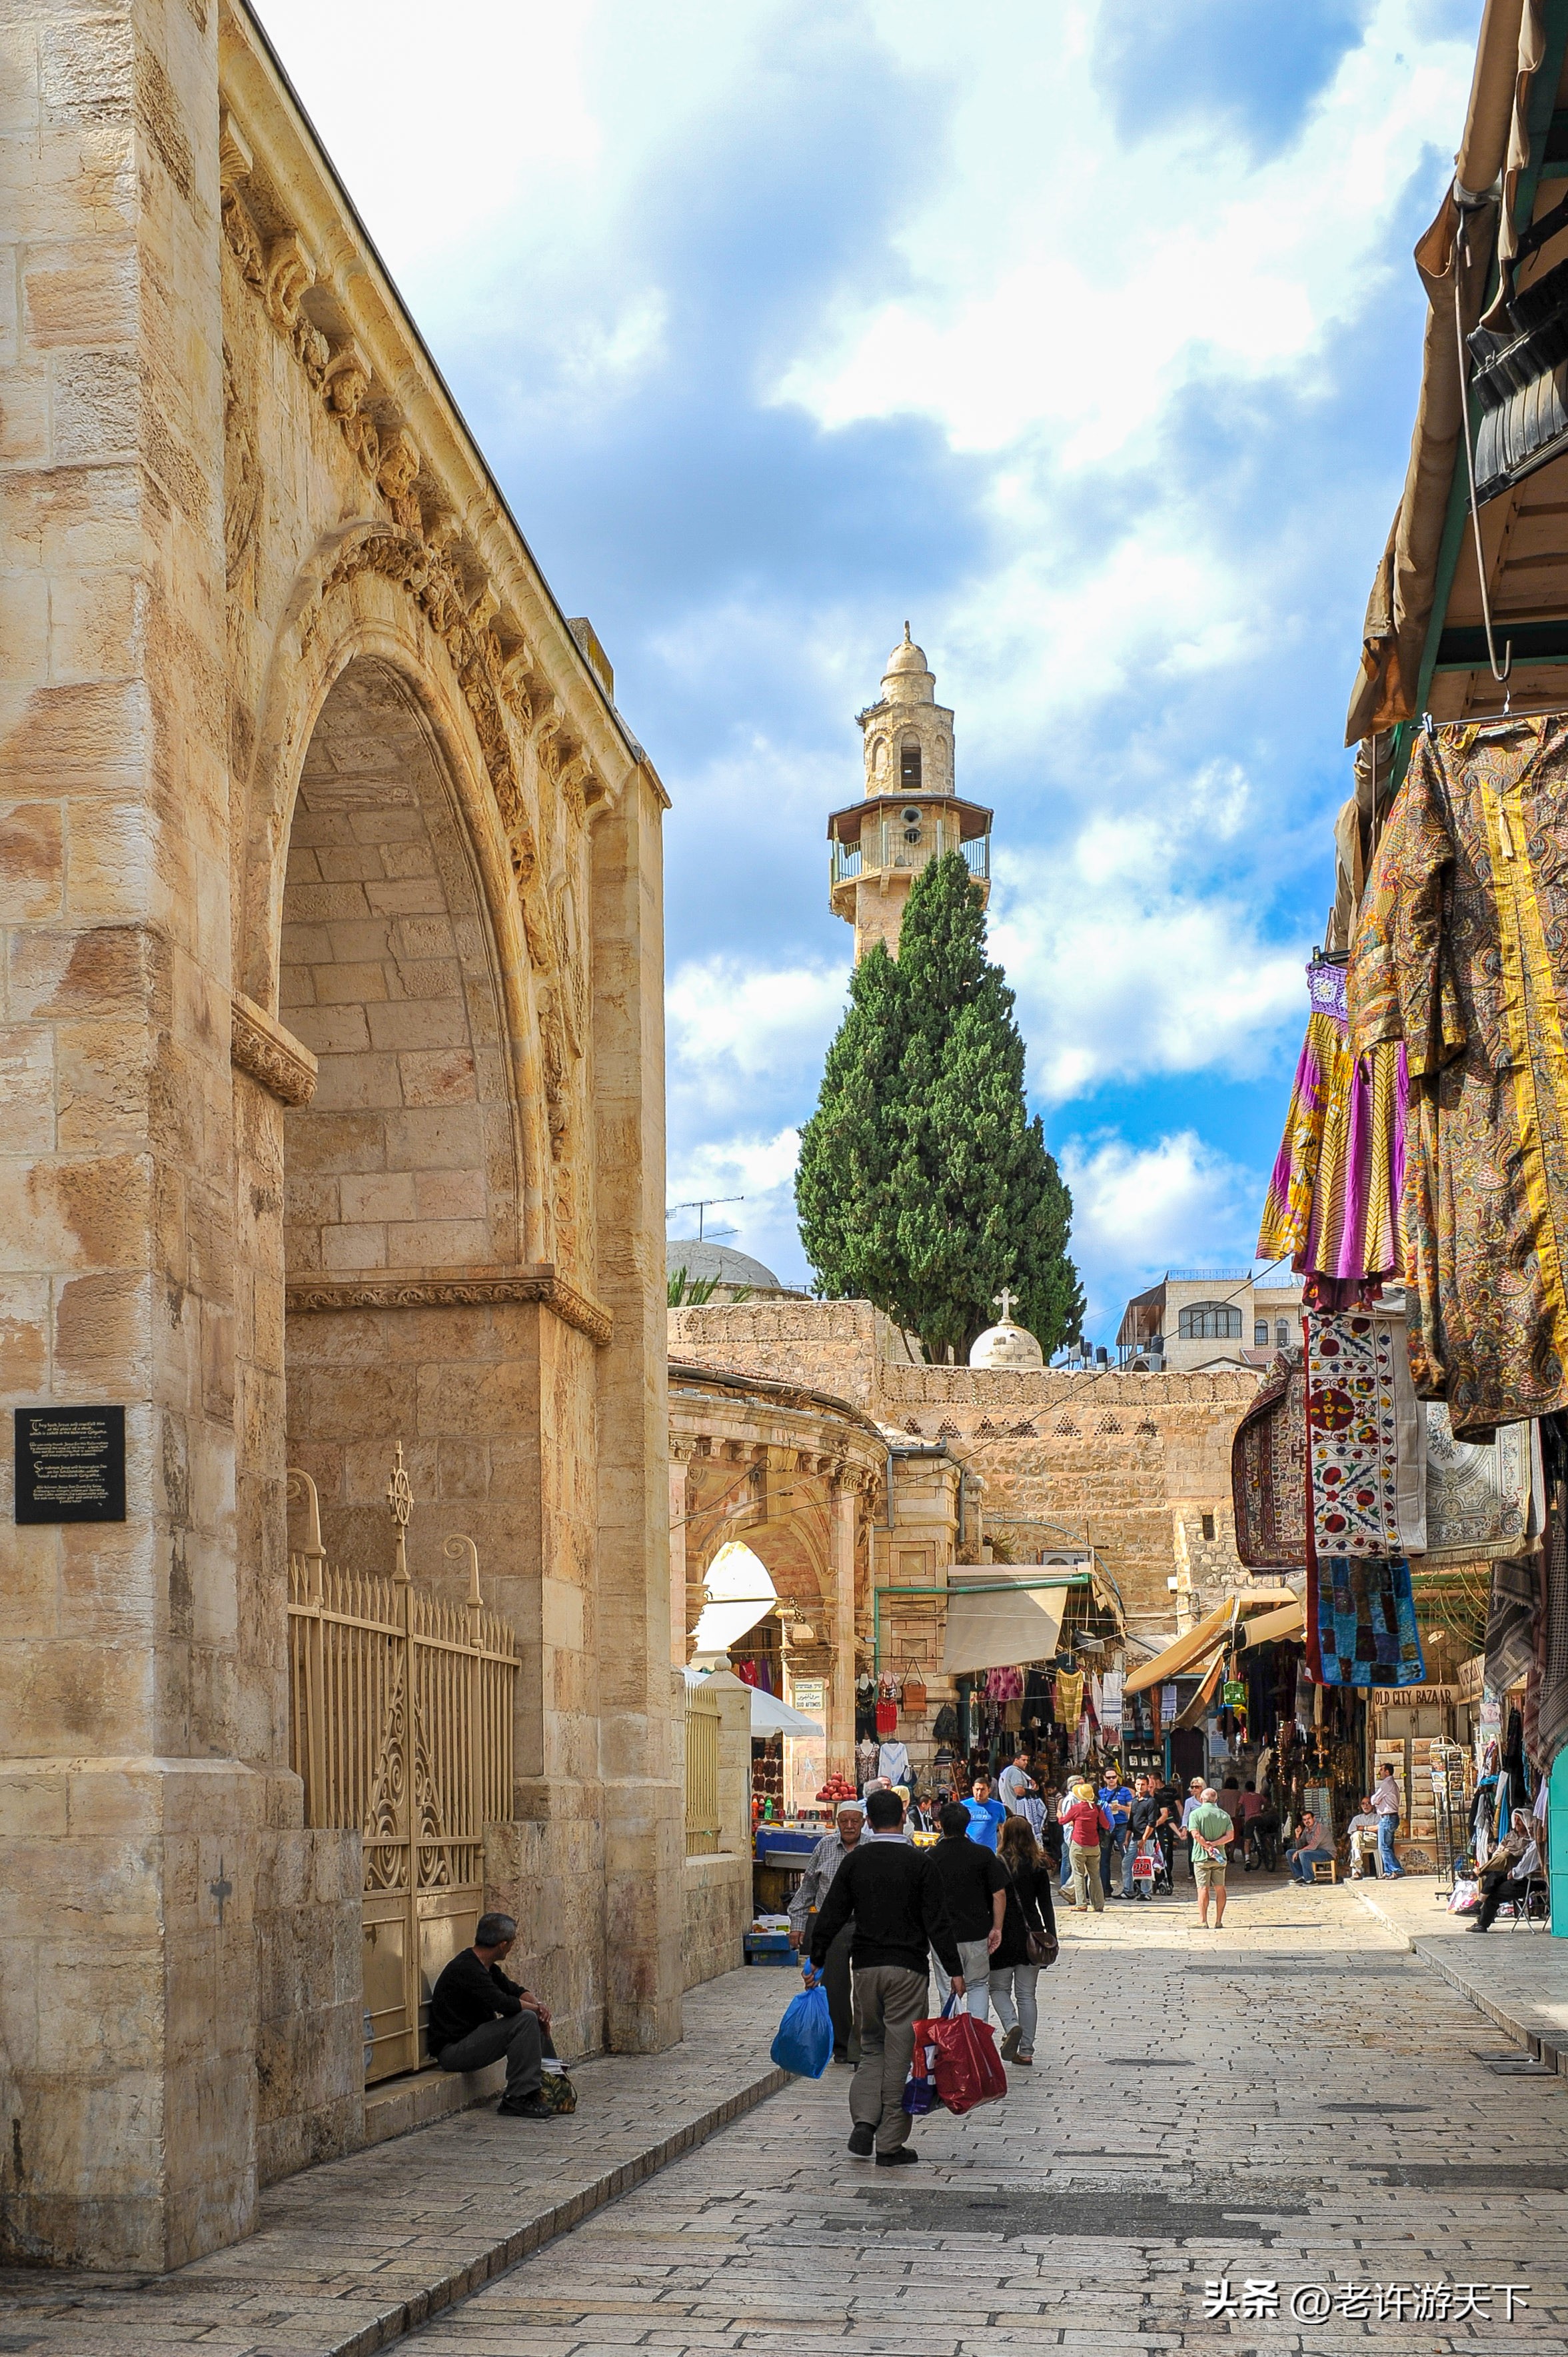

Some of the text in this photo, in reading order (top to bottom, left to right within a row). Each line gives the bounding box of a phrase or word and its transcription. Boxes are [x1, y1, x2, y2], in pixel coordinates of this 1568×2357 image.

[1375, 1689, 1453, 1705] OLD CITY BAZAAR
